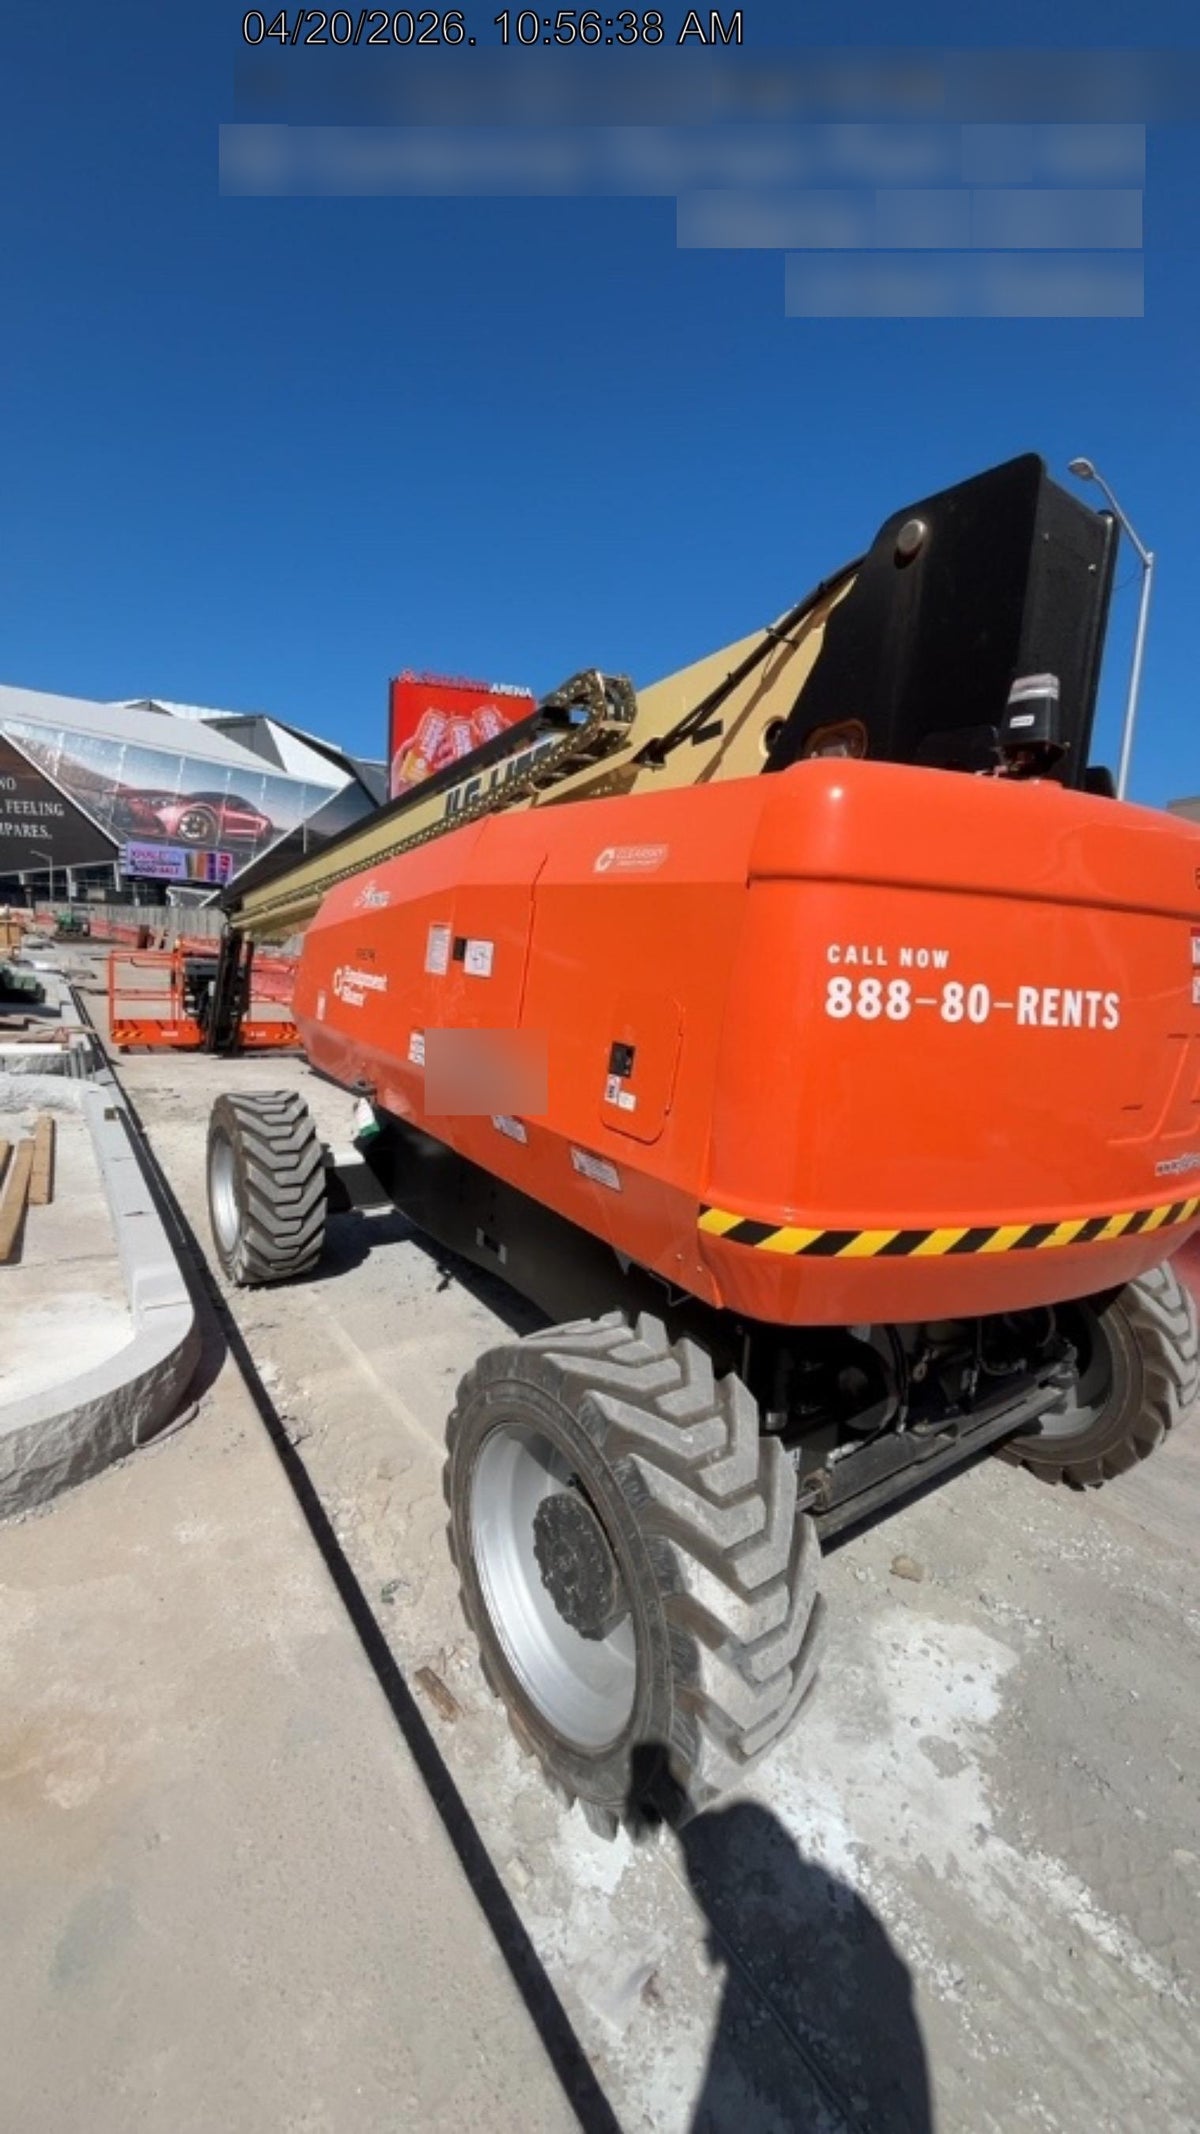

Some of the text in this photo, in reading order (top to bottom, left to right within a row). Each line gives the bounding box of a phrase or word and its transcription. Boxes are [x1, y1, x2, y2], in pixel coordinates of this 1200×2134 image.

[5, 800, 65, 817] FEELING
[827, 944, 949, 969] CALL NOW
[825, 975, 1121, 1031] 888-80-RENTS
